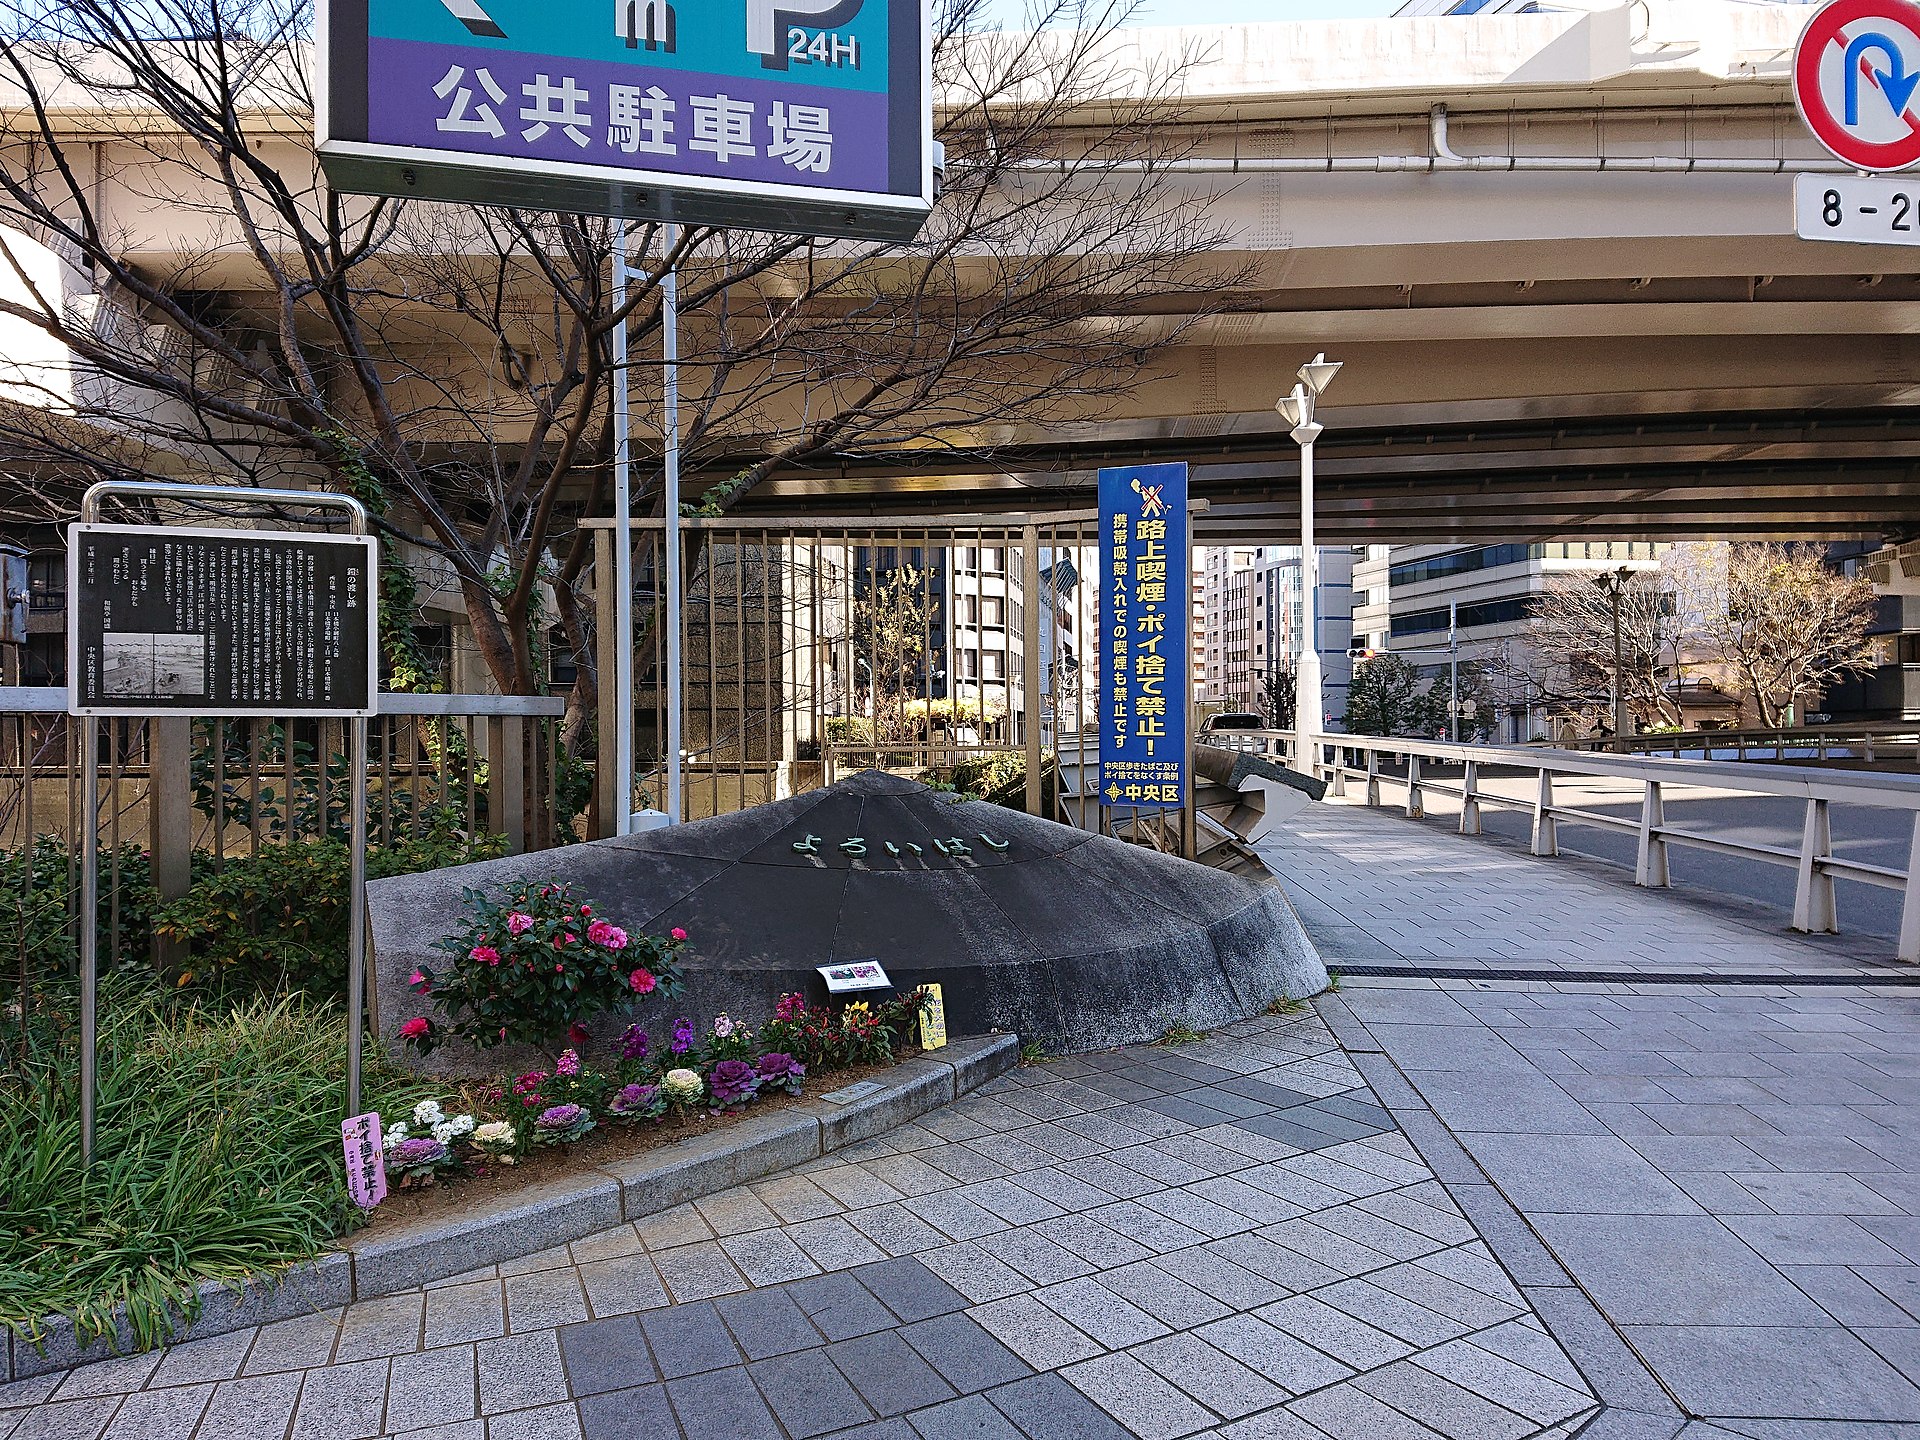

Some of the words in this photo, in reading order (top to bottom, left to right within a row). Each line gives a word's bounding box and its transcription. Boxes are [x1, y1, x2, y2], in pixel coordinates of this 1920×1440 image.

[788, 27, 856, 65] 24H
[431, 64, 834, 173] 公共駐車場
[1822, 189, 1920, 231] 8-2
[1112, 513, 1128, 749] 携帯吸殻入れでの喫煙も禁止です
[1136, 519, 1167, 756] 路上喫煙・ポイ捨て禁止!
[87, 647, 96, 698] 中央区教育委員会
[1104, 762, 1179, 771] 中央区歩きたばこ及び
[1104, 771, 1179, 780] ポイ捨てをなくす条例
[1125, 783, 1179, 802] 中央区
[791, 833, 1011, 860] よろいはし
